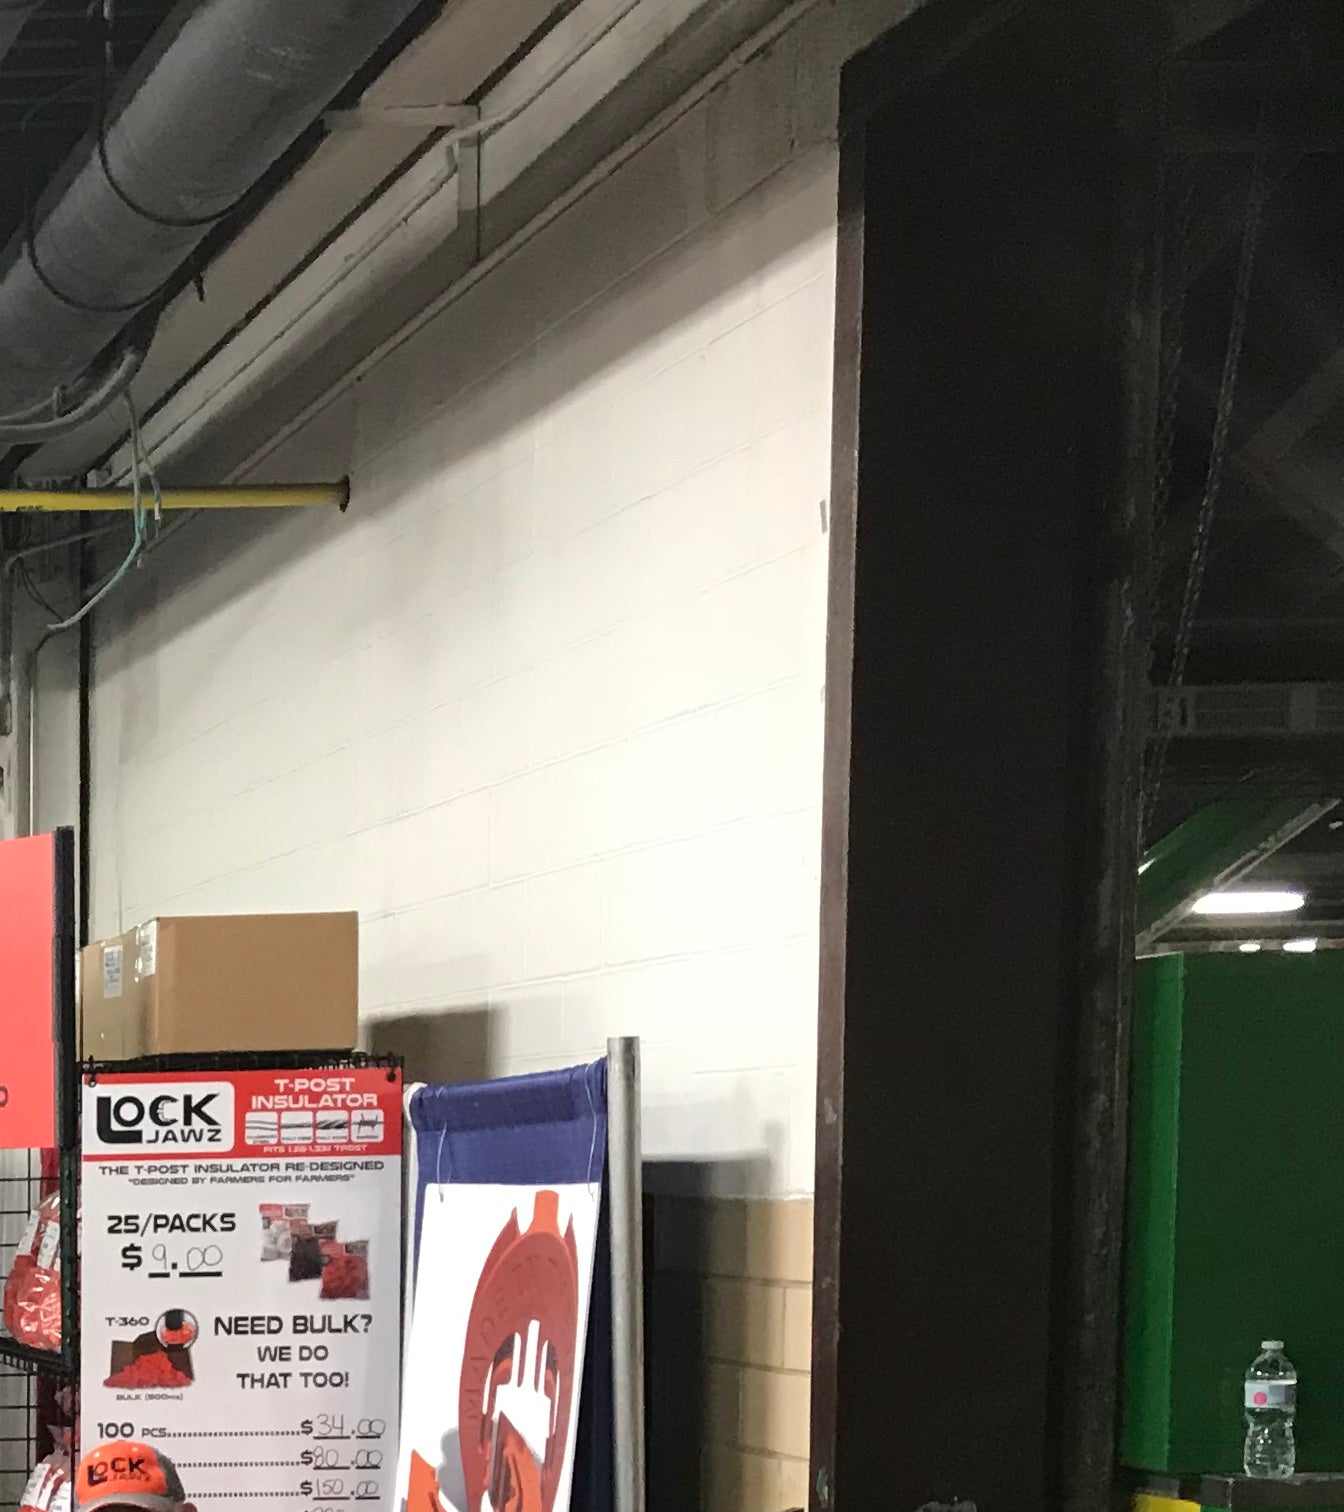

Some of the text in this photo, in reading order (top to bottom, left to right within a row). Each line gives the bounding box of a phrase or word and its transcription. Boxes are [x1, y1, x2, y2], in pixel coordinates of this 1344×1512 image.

[274, 1078, 355, 1093] T-POST
[251, 1093, 378, 1109] INSULATOR
[96, 1092, 221, 1145] LOCK
[146, 1128, 222, 1144] JAWZ
[99, 1160, 385, 1175] THE T-POST INSULATOR RE-DESIGNED
[107, 1213, 236, 1237] 25/PACKS
[105, 1316, 149, 1328] T-360
[214, 1314, 373, 1336] NEED BULK?
[257, 1345, 329, 1362] WE DO
[236, 1371, 350, 1390] THAT TOO!
[97, 1421, 134, 1438] 100
